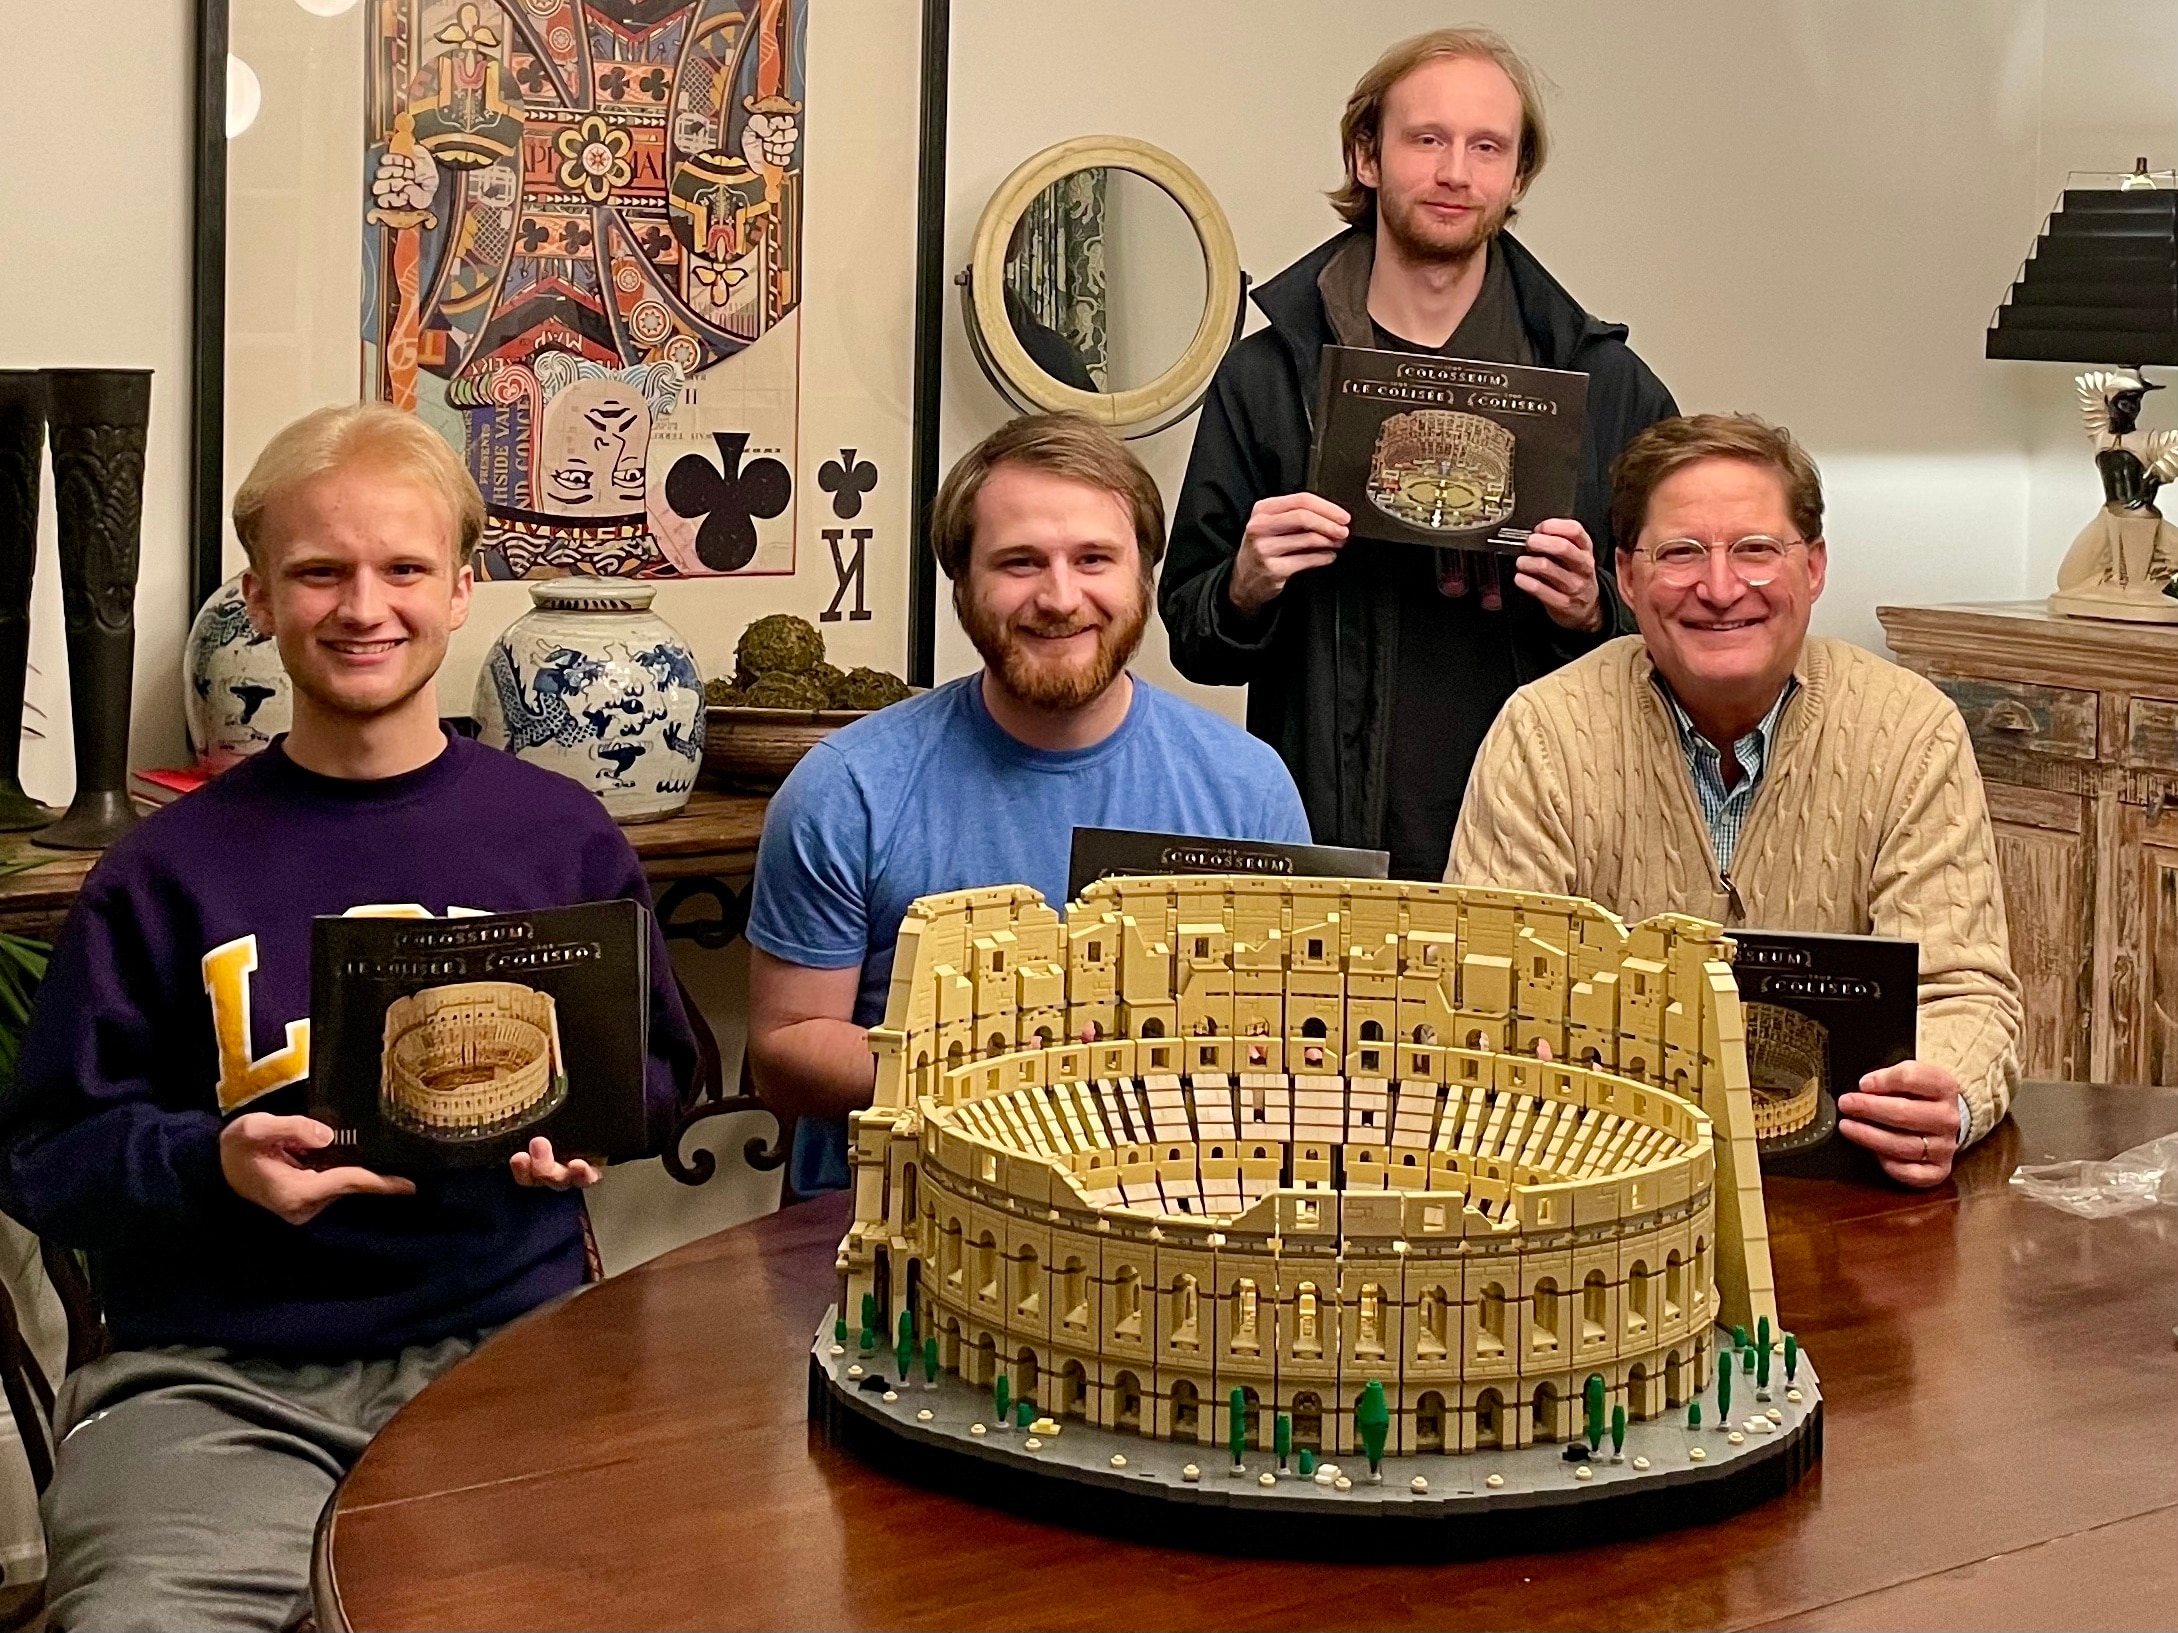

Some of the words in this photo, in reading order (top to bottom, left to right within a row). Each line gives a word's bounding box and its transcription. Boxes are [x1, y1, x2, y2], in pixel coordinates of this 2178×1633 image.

[1404, 366, 1502, 386] COLOSSEUM
[1352, 383, 1371, 393] LE
[1477, 396, 1548, 412] COLISEO
[479, 423, 491, 485] PRESENTS
[1170, 851, 1286, 871] COLOSSEUM
[499, 948, 589, 966] COLISEO
[1775, 979, 1867, 994] COLISEO
